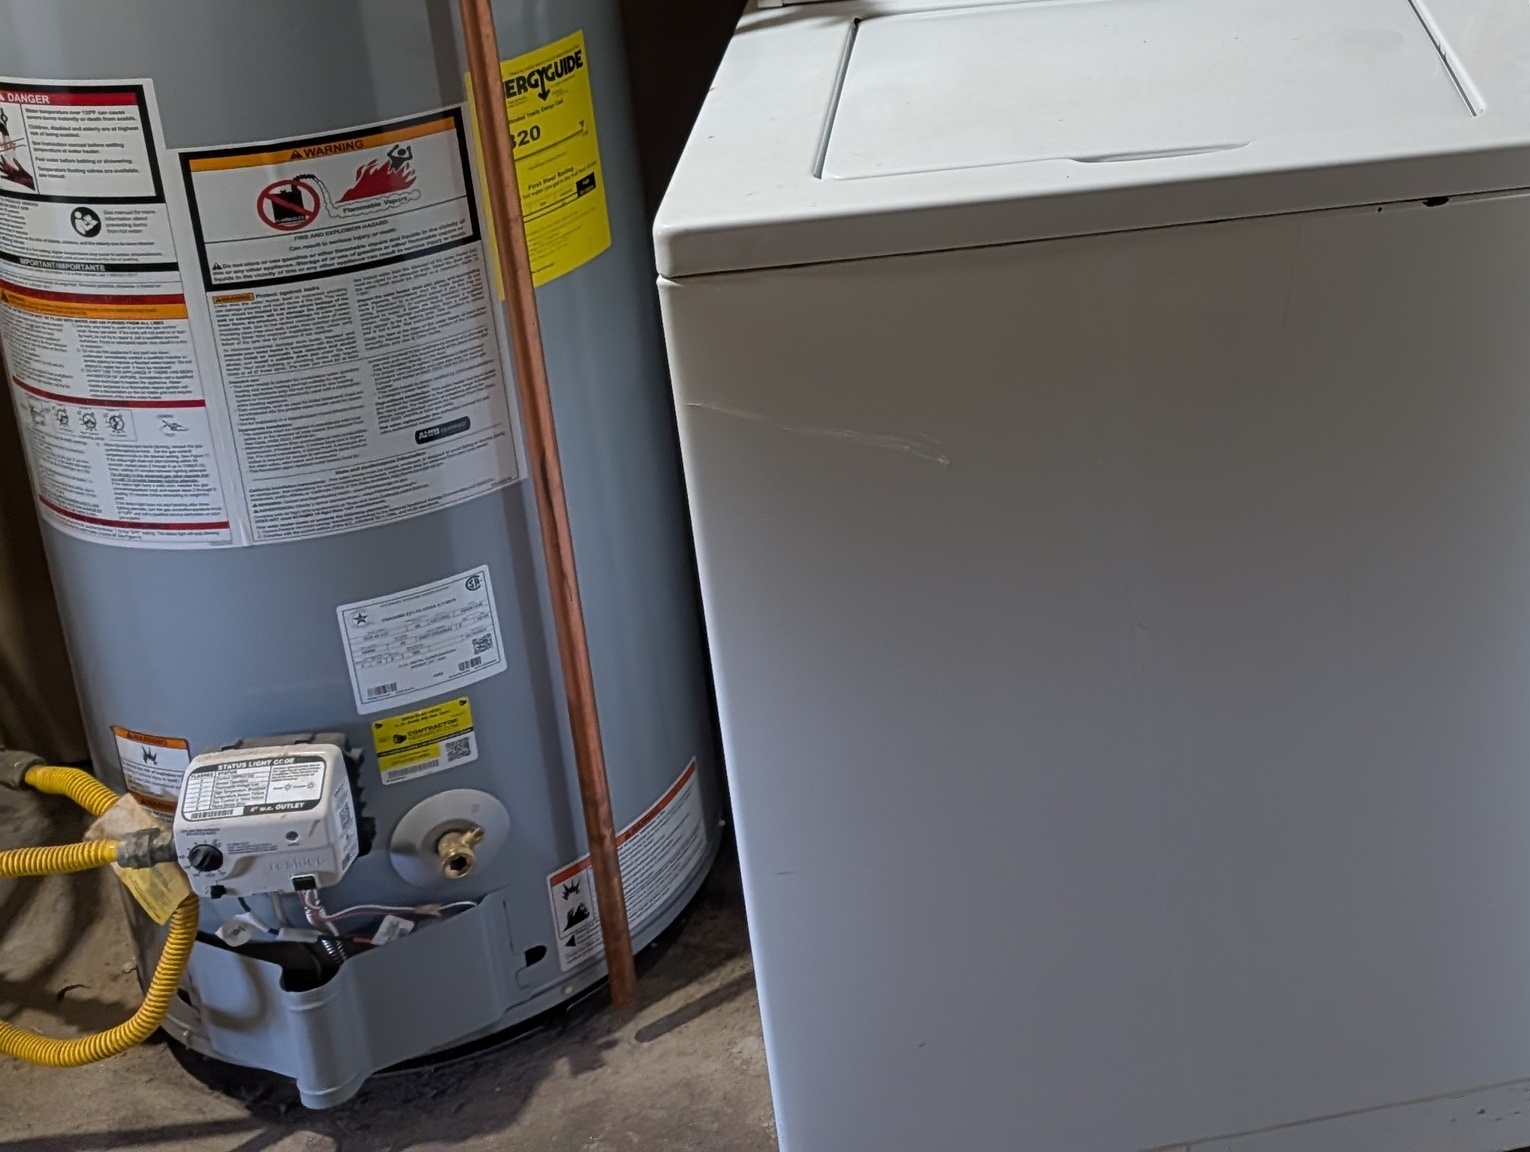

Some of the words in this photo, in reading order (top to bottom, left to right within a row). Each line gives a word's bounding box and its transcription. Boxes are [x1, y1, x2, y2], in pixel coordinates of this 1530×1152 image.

[504, 49, 584, 101] ERGYGUIDE
[7, 92, 50, 104] DANGER
[303, 140, 364, 159] WARNING
[343, 202, 381, 214] Flammable
[384, 196, 408, 205] Vapors
[407, 718, 458, 736] CONTRACTOR
